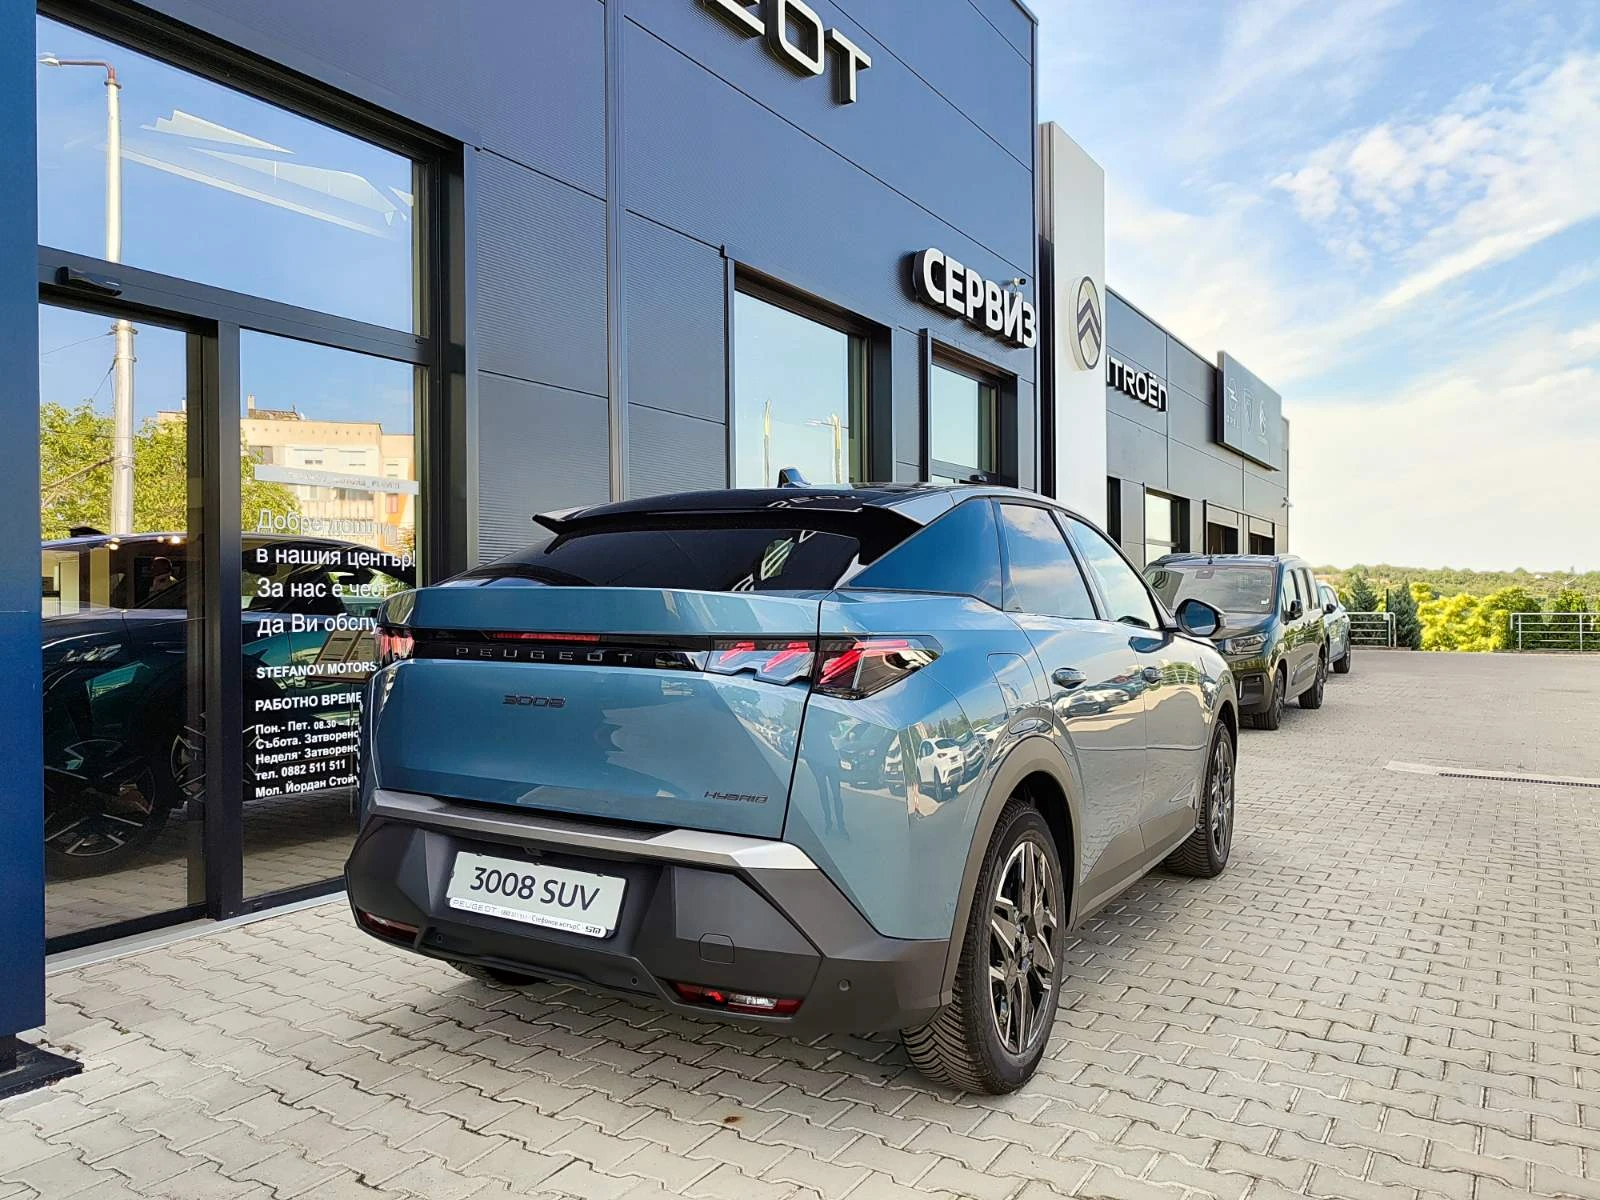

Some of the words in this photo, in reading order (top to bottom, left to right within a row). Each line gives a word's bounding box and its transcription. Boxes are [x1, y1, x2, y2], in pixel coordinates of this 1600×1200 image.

[921, 247, 1037, 349] СЕРВИЗ
[1106, 354, 1169, 411] ITROËN
[257, 508, 323, 535] Добре
[256, 548, 268, 563] в
[275, 550, 341, 566] нашия
[347, 551, 416, 571] център!
[257, 577, 284, 597] За
[290, 582, 326, 598] нас
[332, 584, 343, 597] е
[350, 583, 389, 598] чест
[256, 617, 284, 637] да
[291, 613, 318, 633] Ви
[324, 612, 378, 634] обслу
[456, 647, 633, 663] PEUGEOT
[256, 664, 324, 679] STEFANOV
[327, 661, 377, 675] MOTORS
[255, 695, 318, 712] РАБОТНО
[321, 692, 362, 706] ВРЕМЕ
[502, 694, 567, 708] 3008
[287, 721, 311, 731] Пет.
[313, 720, 337, 730] 08.30
[255, 737, 302, 750] Събота.
[255, 771, 279, 781] тел.
[281, 764, 307, 777] 0882
[309, 762, 326, 773] 511
[329, 759, 346, 770] 511
[285, 780, 327, 794] Йордан
[703, 791, 769, 804] HYBRID
[470, 866, 536, 900] 3008
[540, 879, 600, 911] SUV
[452, 899, 497, 913] PEUGEOT
